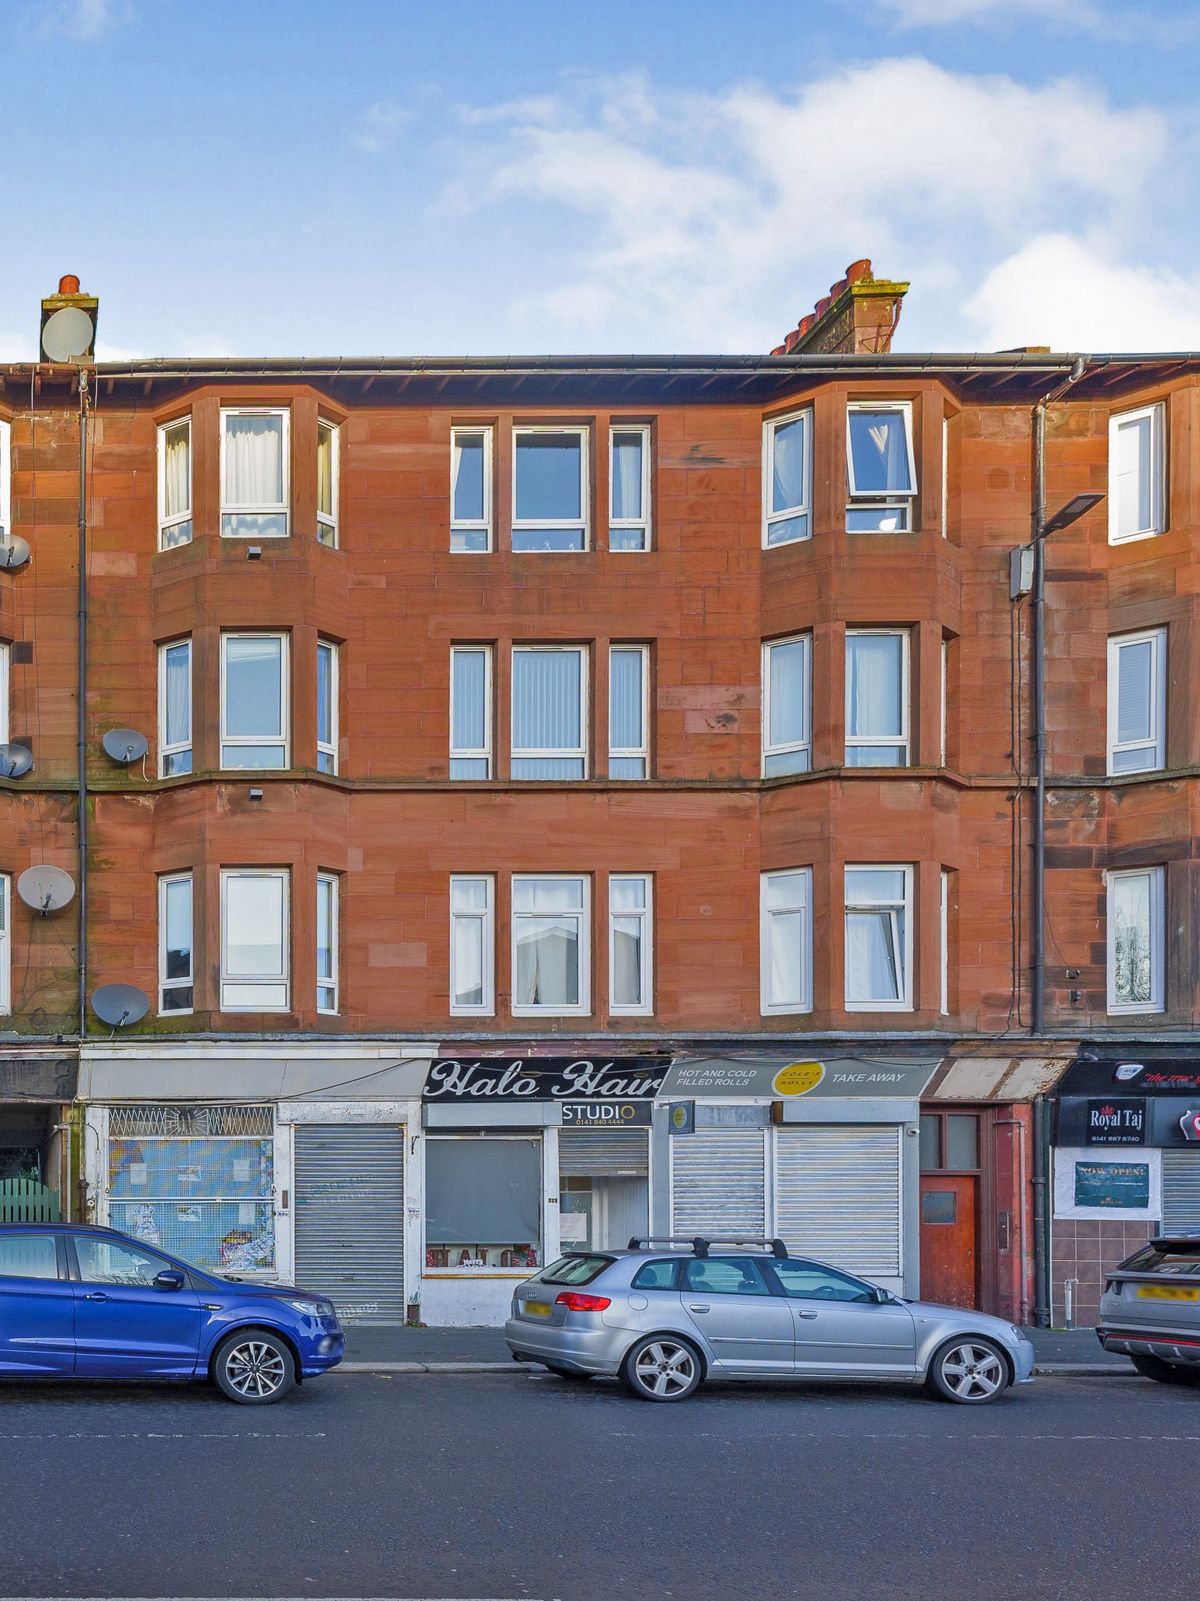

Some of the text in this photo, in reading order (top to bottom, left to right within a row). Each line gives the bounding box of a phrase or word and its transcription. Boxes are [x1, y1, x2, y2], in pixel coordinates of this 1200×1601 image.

[422, 1060, 663, 1096] Halo Hair
[716, 1078, 750, 1086] ROLLS
[832, 1073, 906, 1083] TAKE AWAY
[562, 1105, 635, 1120] STUDIO
[1091, 1110, 1143, 1131] Royal Taj
